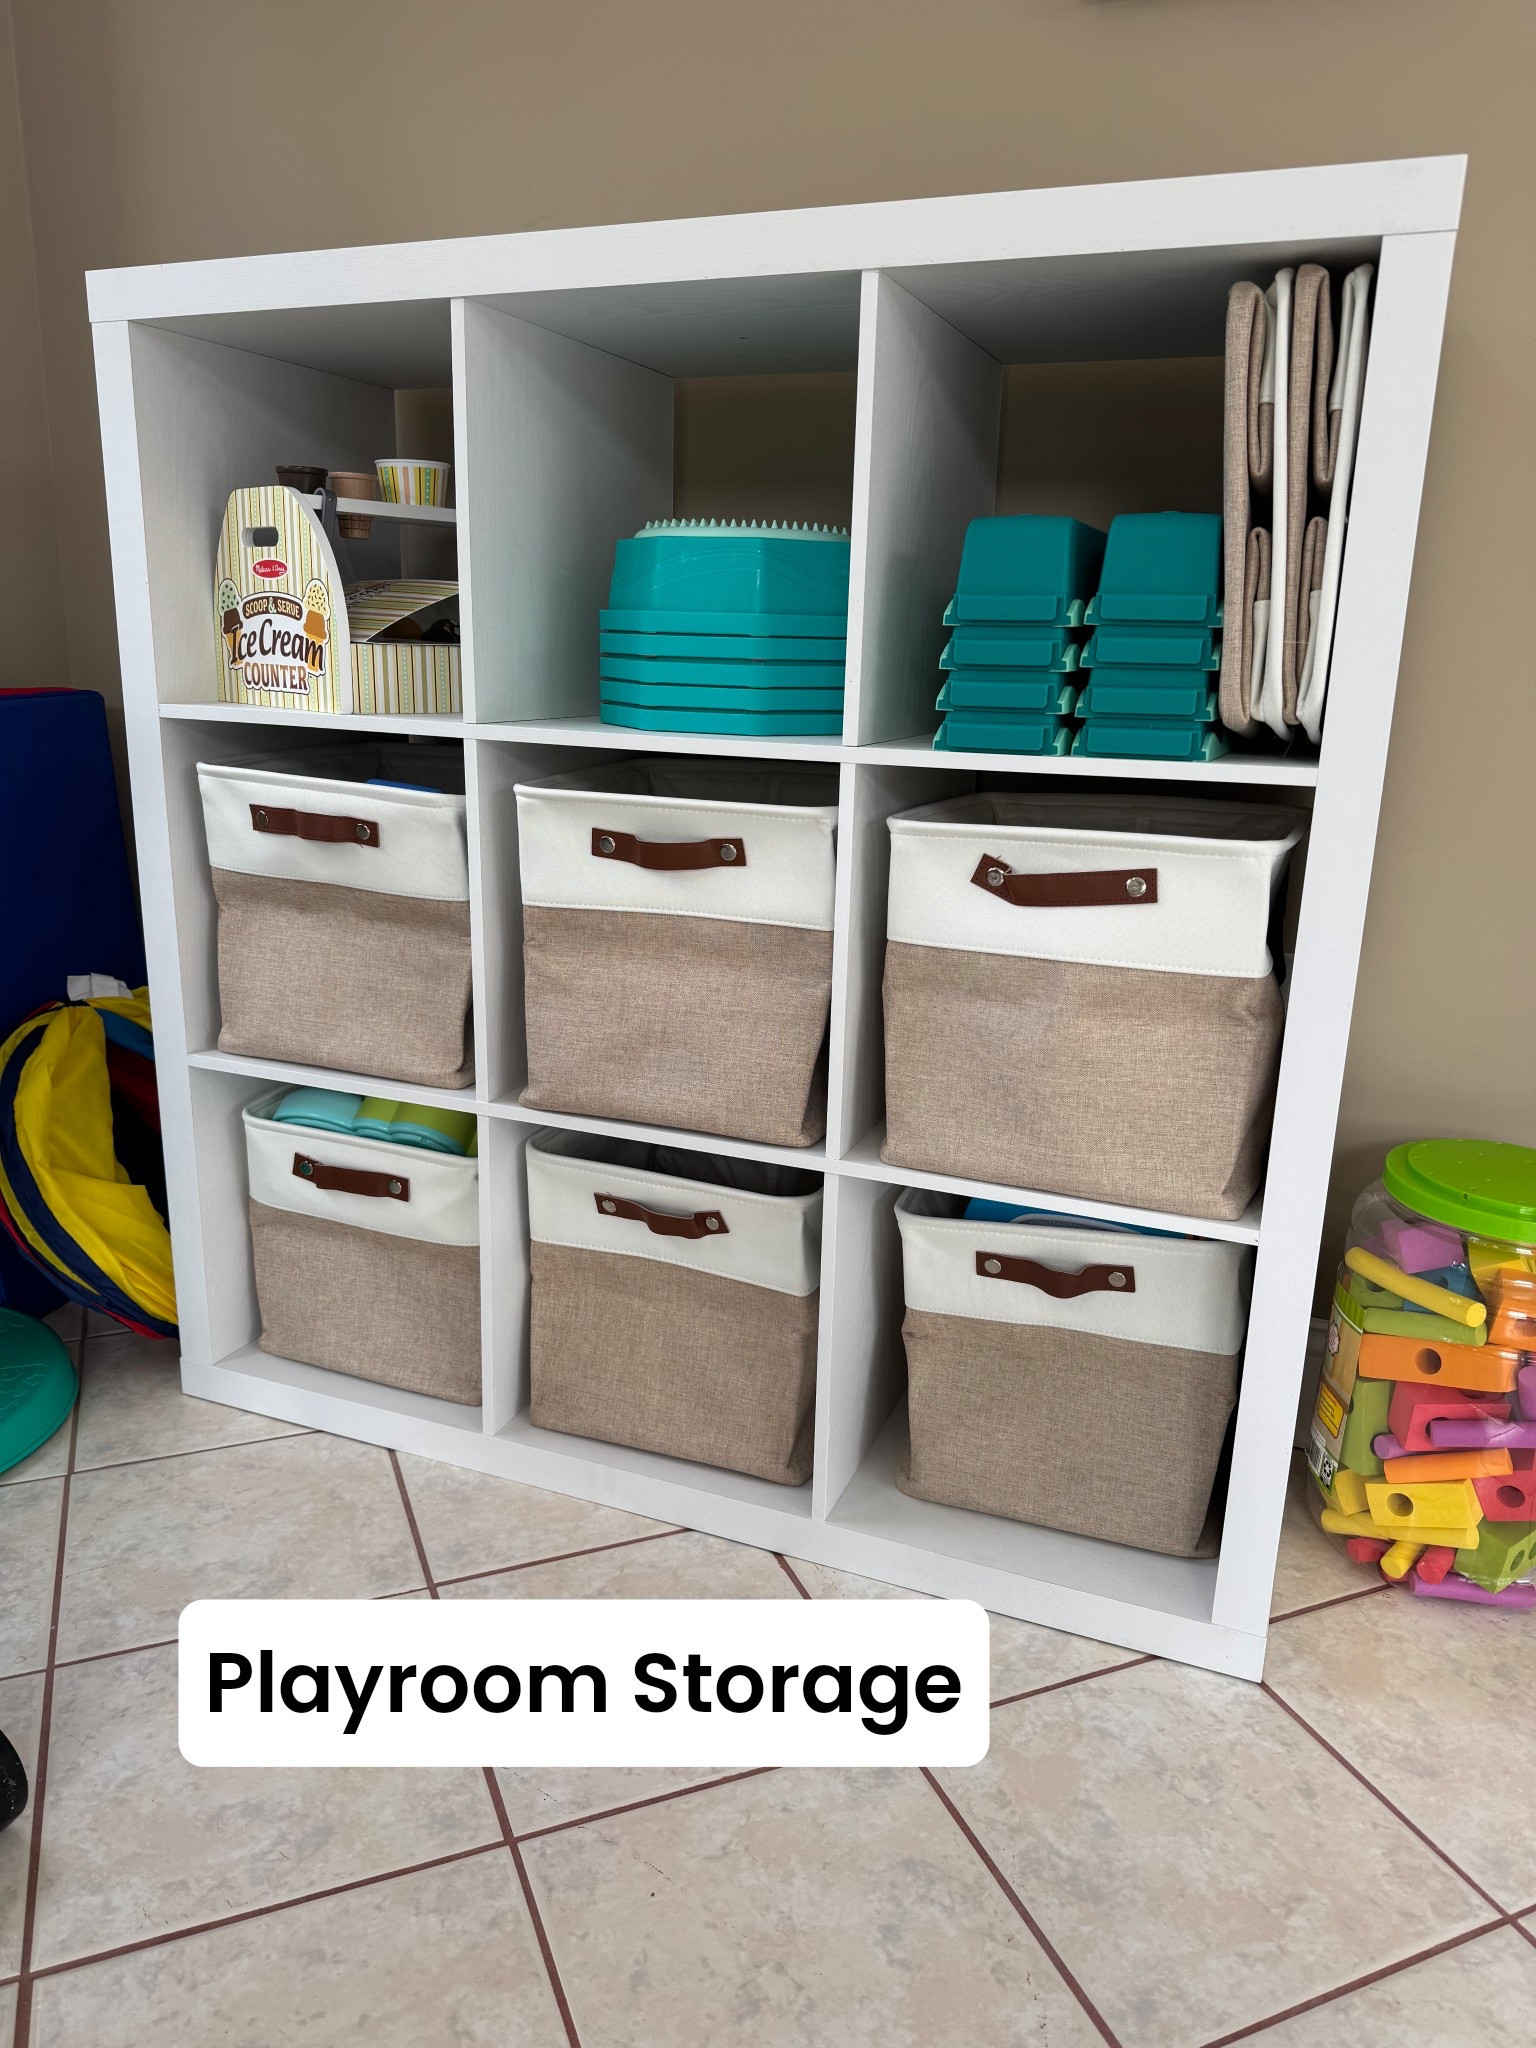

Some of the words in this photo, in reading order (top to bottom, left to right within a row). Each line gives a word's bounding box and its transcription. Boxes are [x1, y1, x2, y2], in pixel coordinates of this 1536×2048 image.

[245, 600, 268, 617] SCOOP
[268, 596, 277, 614] &
[277, 600, 301, 619] SERVE
[231, 627, 257, 665] Ice
[258, 618, 324, 671] Cream
[243, 661, 308, 691] COUNTER
